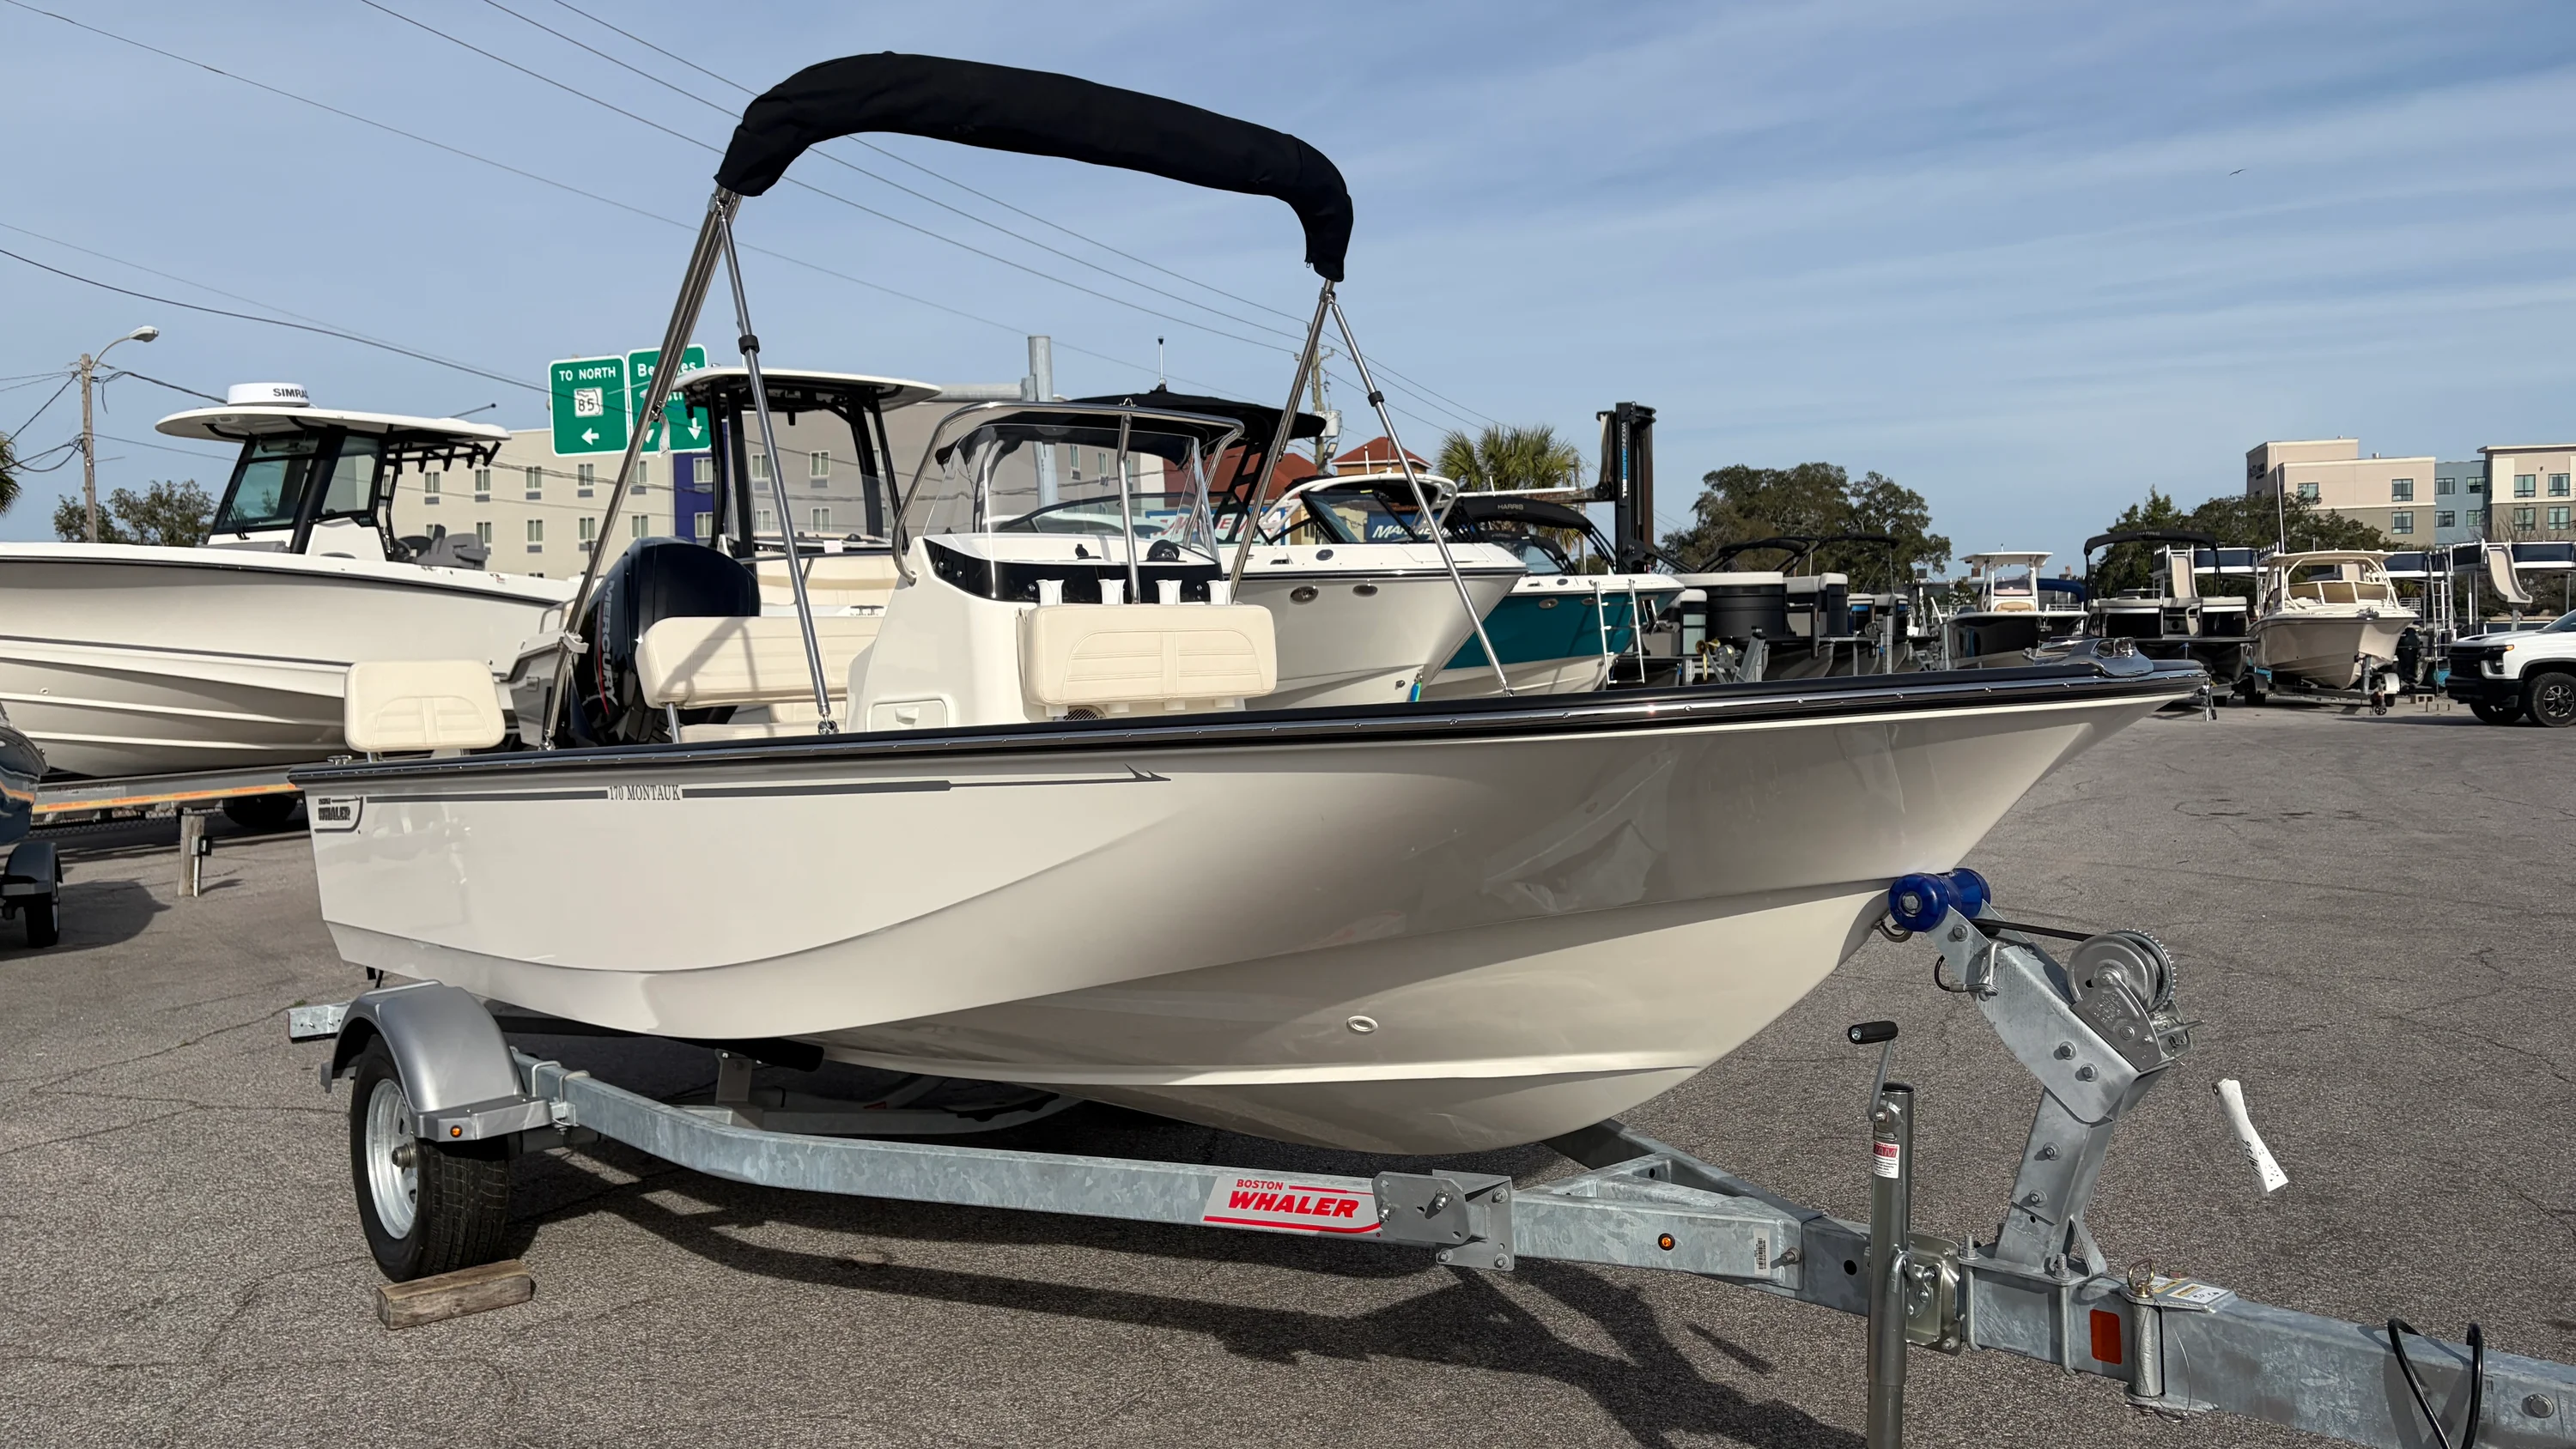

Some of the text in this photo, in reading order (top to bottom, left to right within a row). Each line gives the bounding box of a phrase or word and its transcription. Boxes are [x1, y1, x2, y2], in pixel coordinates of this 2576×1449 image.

[558, 366, 617, 382] TO NORTH
[578, 398, 595, 412] 85
[602, 580, 619, 706] MERCURY
[609, 785, 681, 801] 170 MONTAUK
[1236, 1179, 1284, 1191] BOSTON
[1228, 1191, 1359, 1218] WHALER
